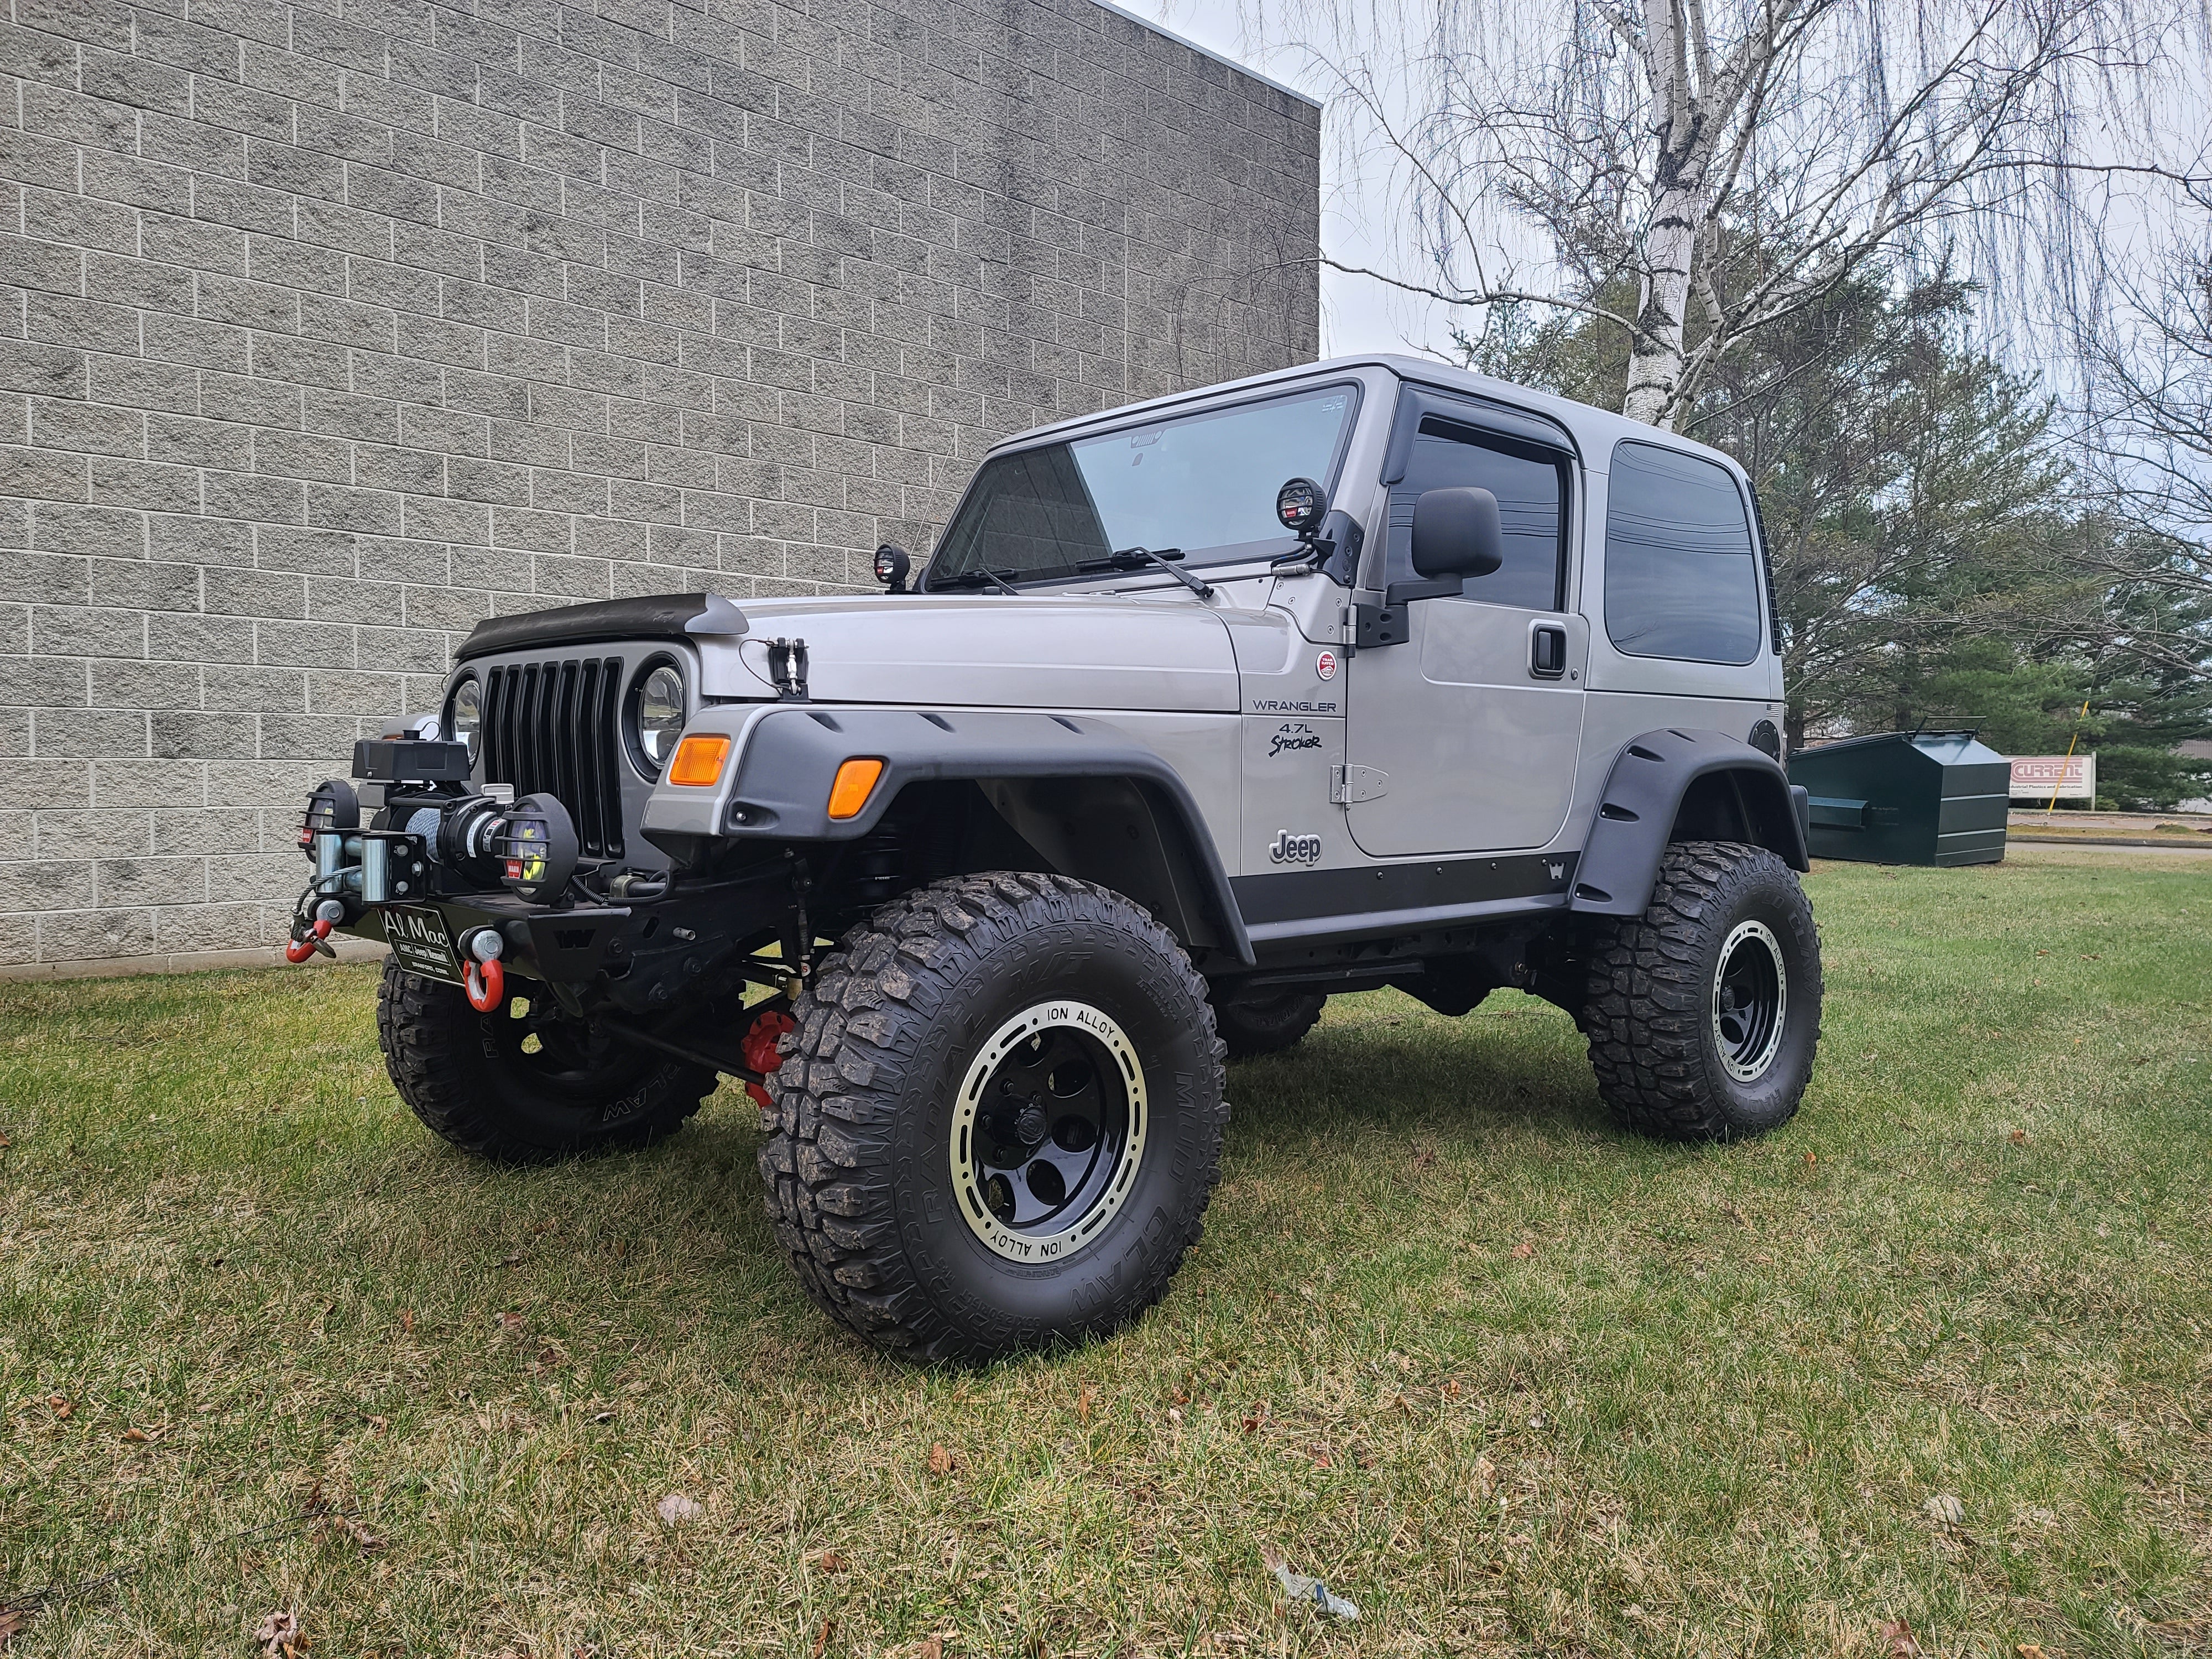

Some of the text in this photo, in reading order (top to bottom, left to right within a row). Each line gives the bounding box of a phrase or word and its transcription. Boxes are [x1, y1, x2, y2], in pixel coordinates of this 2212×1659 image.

[1252, 700, 1337, 712] WRANGLER
[1279, 723, 1313, 733] 4.7L
[1272, 833, 1321, 862] Jeep
[384, 910, 449, 947] Al Mac
[399, 943, 413, 954] AMC
[414, 946, 427, 958] Jeep
[1773, 947, 1784, 975] ALLOY
[1047, 1008, 1114, 1039] ION ALLOY
[1714, 1029, 1735, 1073] ALLOY ION
[920, 1013, 987, 1224] RADIAL
[1067, 1071, 1197, 1318] MUD CLAW
[990, 1230, 1062, 1257] ALLOY ION
